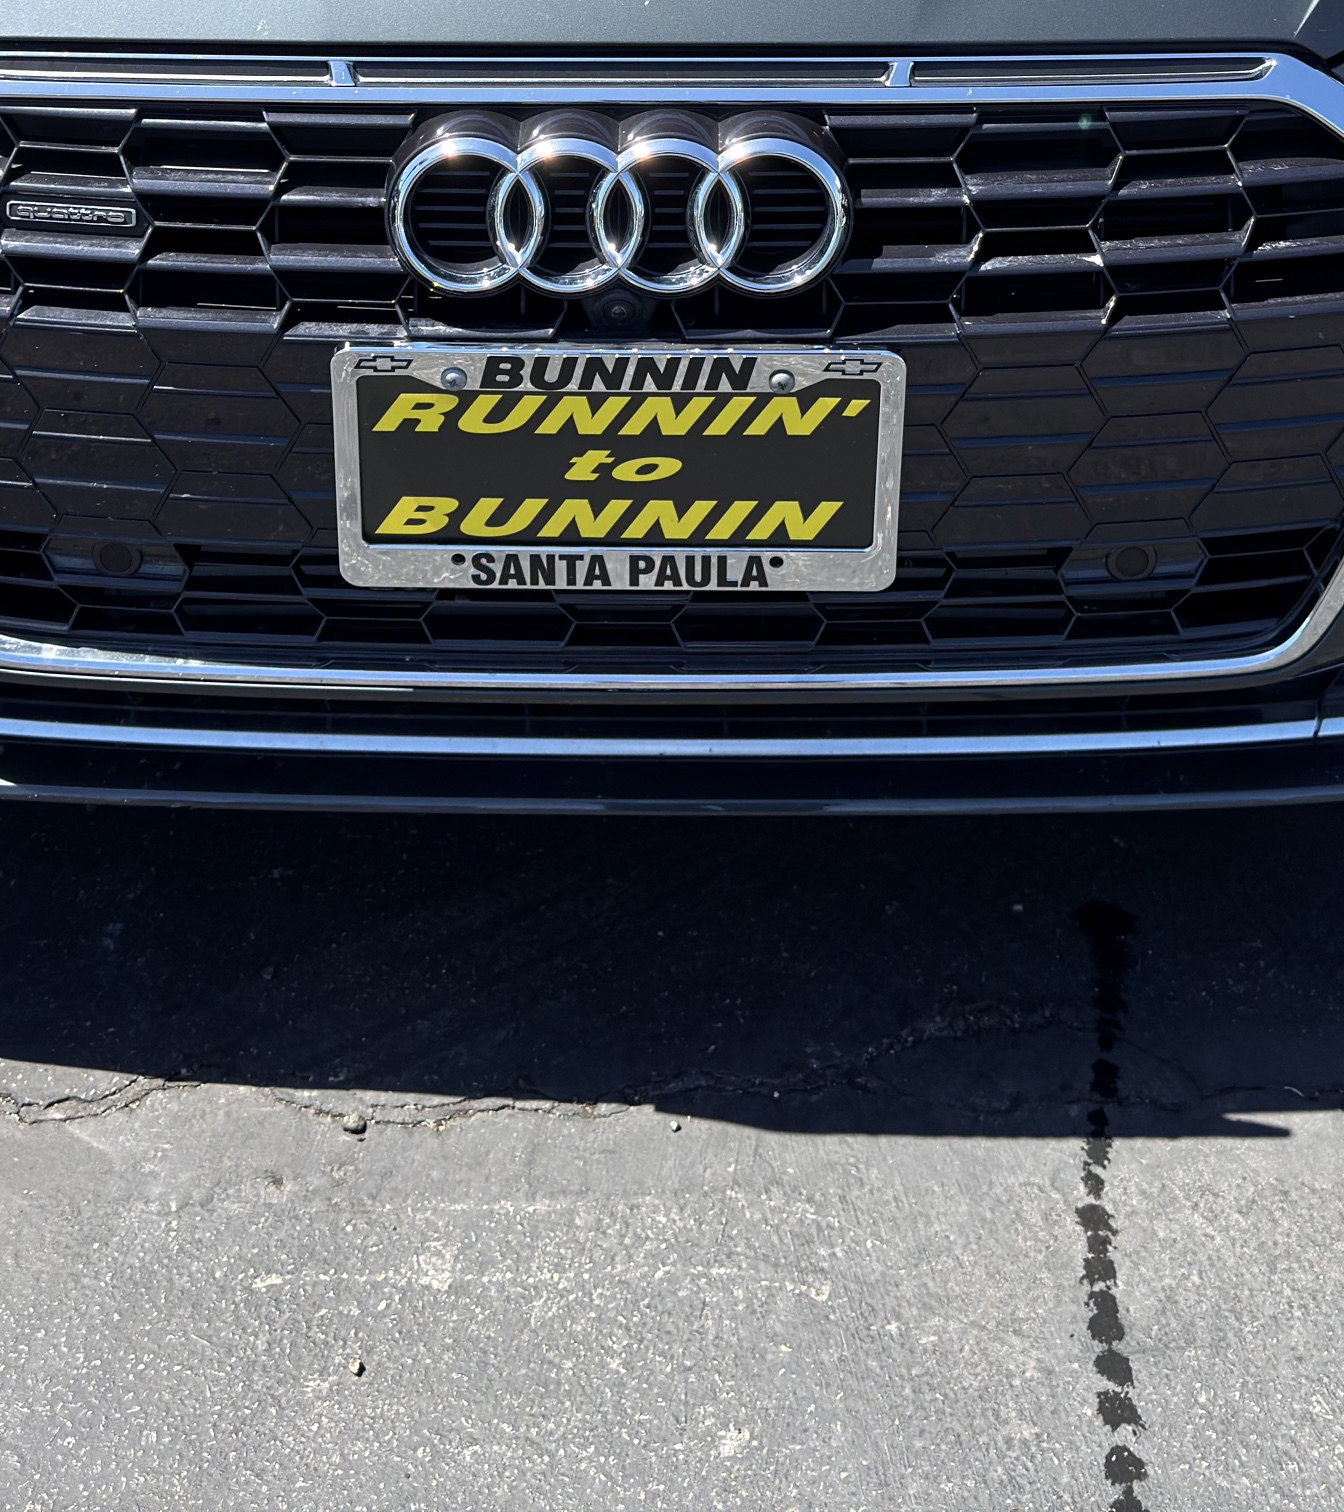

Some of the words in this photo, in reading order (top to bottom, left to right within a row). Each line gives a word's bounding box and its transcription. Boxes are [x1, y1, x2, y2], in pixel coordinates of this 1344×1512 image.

[16, 205, 125, 223] quattro
[480, 355, 758, 392] BUNNIN
[372, 393, 871, 436] RUNNIN'
[564, 449, 682, 482] to
[374, 496, 843, 541] BUNNIN
[470, 552, 612, 588] SANTA
[629, 553, 768, 589] PAULA
